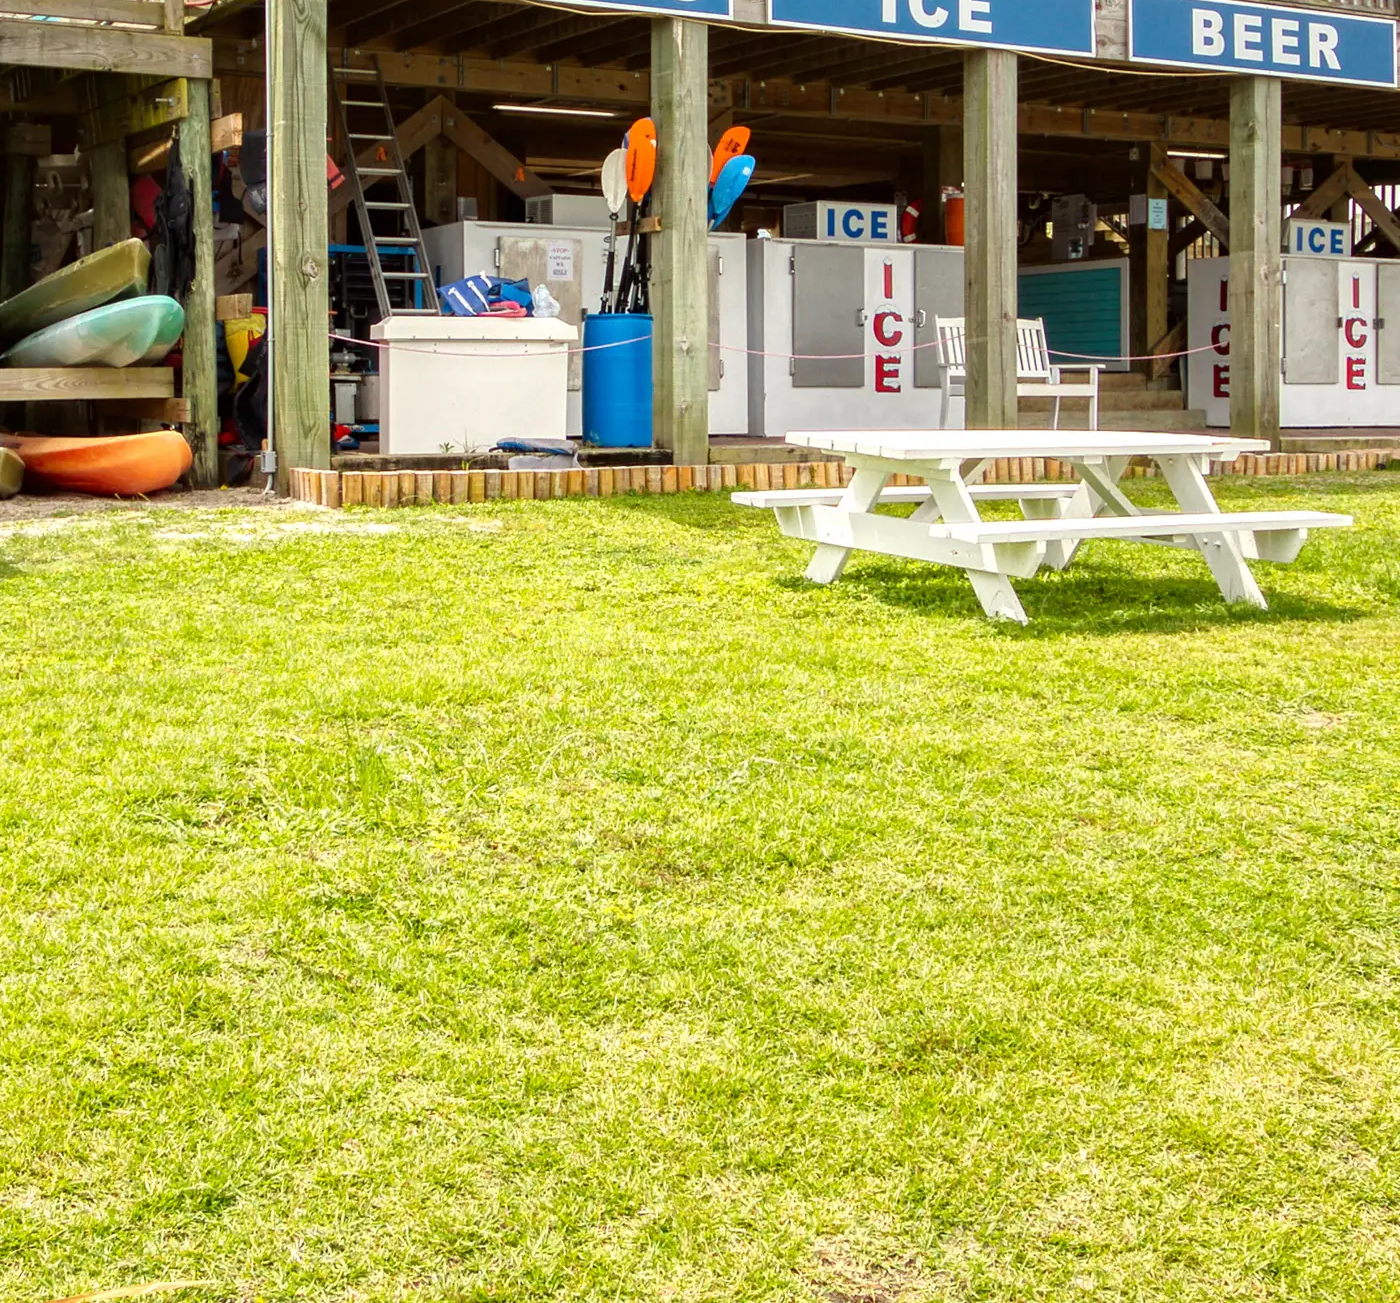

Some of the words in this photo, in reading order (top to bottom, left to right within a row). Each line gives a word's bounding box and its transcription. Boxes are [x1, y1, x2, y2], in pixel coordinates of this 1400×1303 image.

[1192, 8, 1341, 70] BEER
[827, 208, 889, 239] ICE
[1295, 226, 1344, 254] ICE
[873, 256, 904, 393] ICE
[1344, 271, 1368, 390] ICE
